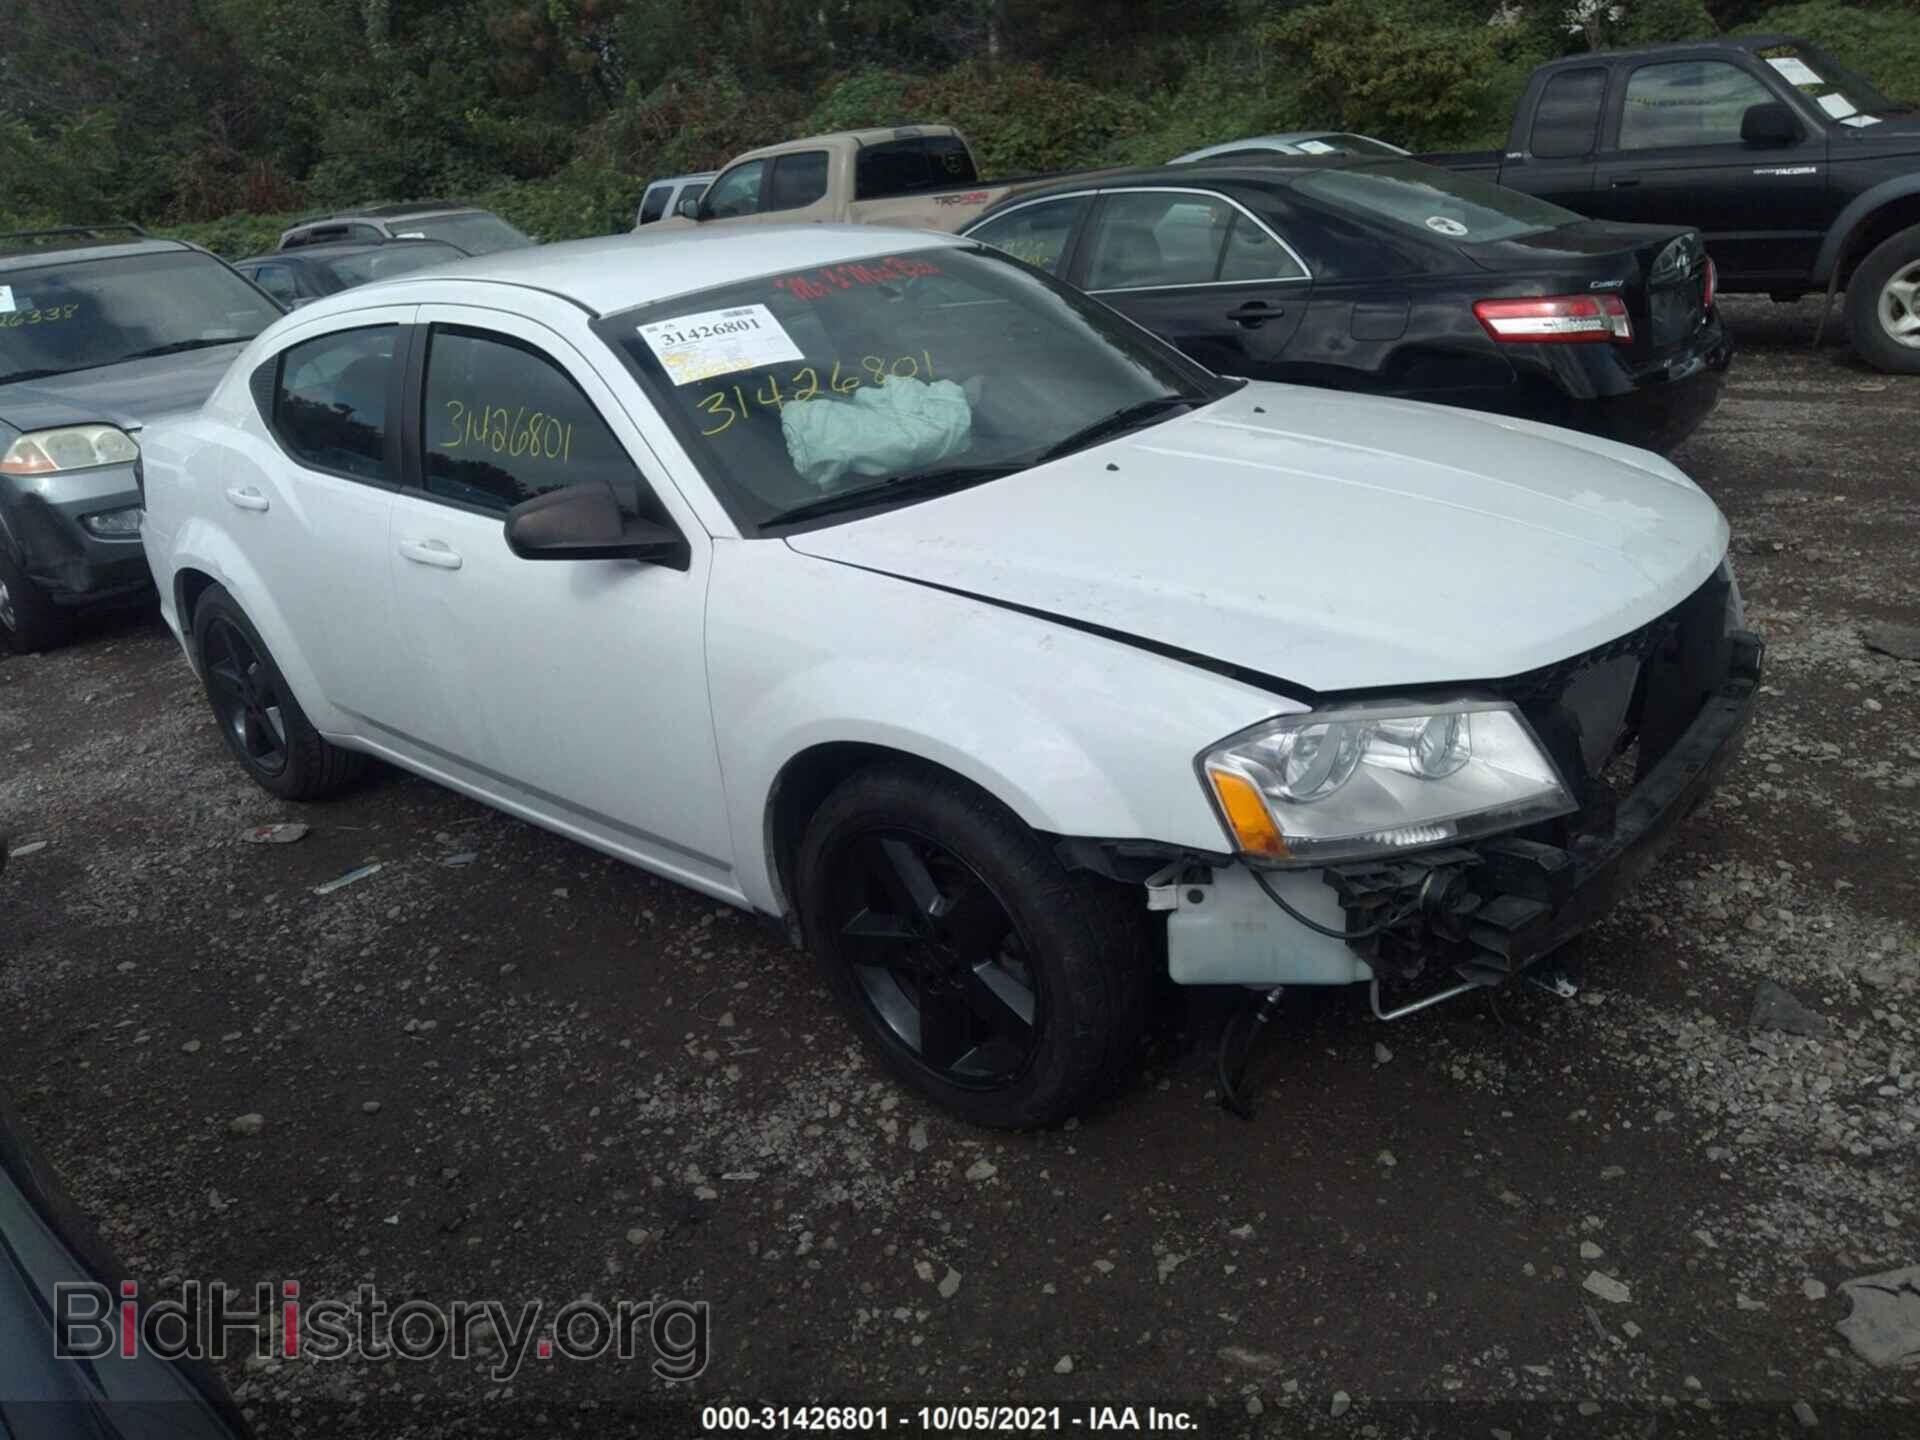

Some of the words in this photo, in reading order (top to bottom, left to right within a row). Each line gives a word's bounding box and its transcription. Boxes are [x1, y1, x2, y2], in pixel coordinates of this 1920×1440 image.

[661, 318, 761, 346] 31426801
[696, 351, 933, 436] 31426801
[440, 400, 572, 464] 31426801
